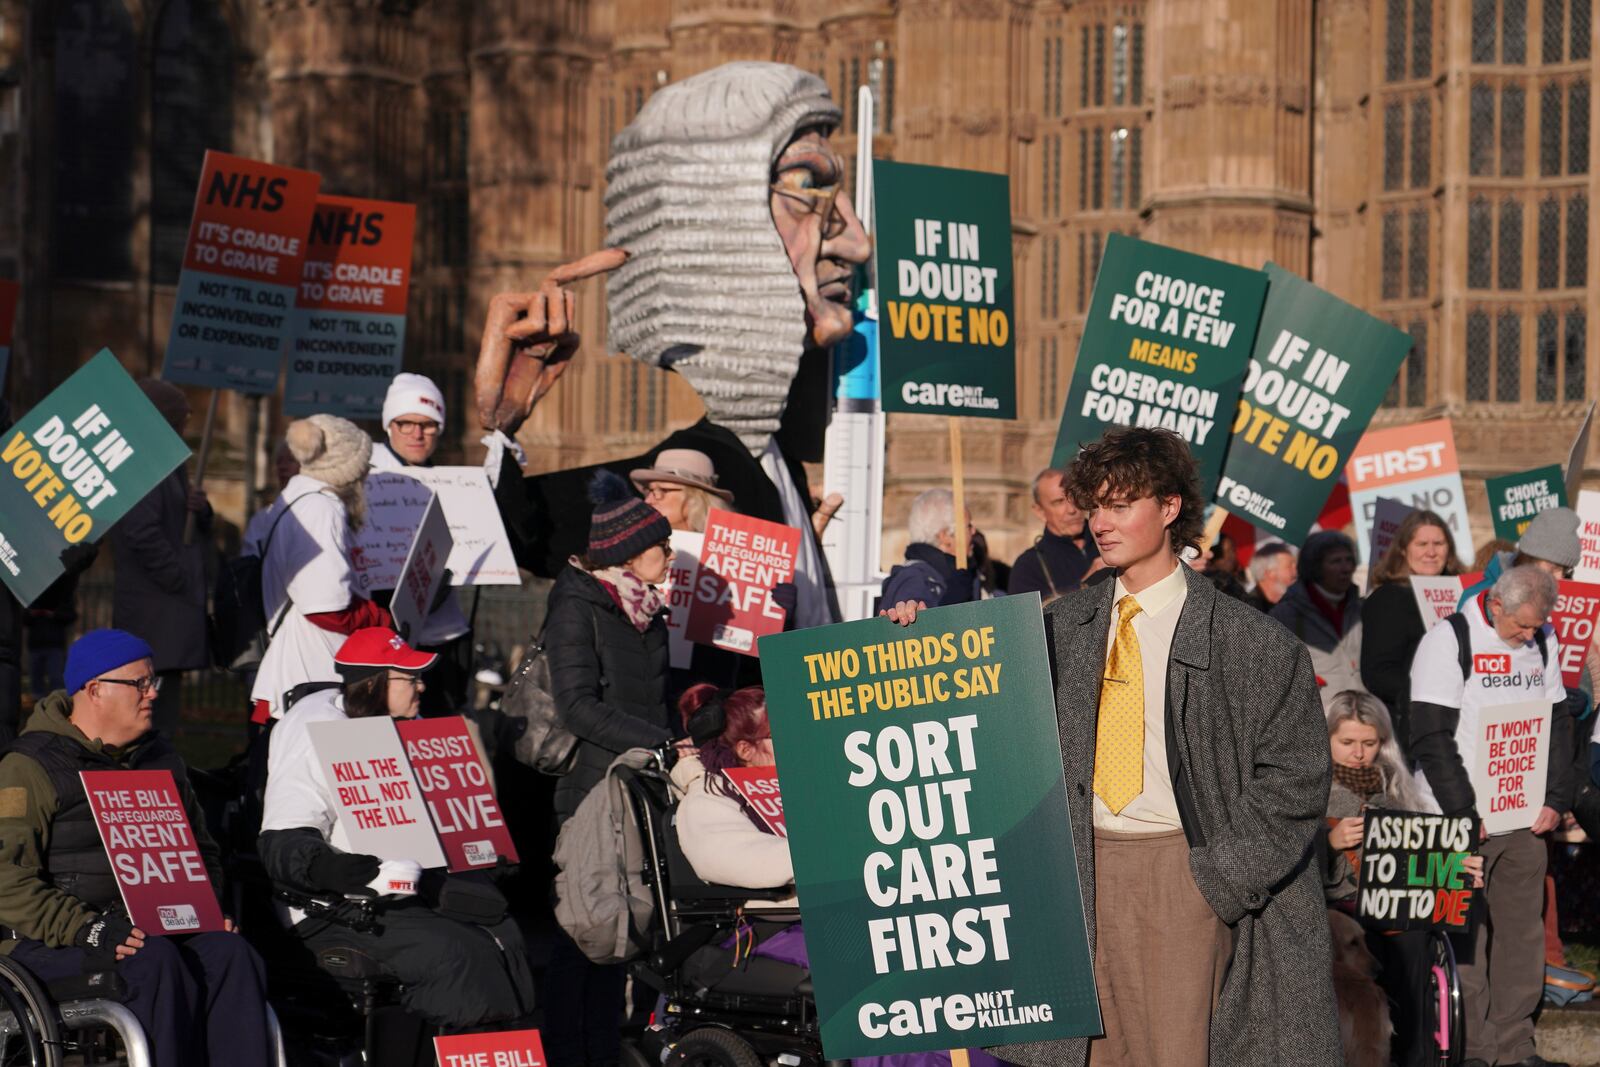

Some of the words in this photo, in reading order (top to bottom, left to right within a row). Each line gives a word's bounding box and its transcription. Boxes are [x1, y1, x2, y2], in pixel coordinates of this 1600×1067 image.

[205, 171, 287, 213] NHS
[199, 222, 230, 243] IT'S
[232, 227, 300, 256] CRADLE
[308, 211, 384, 245] NHS
[914, 218, 942, 257] IF
[948, 222, 980, 261] IN
[195, 244, 218, 263] TO
[222, 249, 278, 274] GRAVE
[303, 261, 332, 280] IT'S
[336, 263, 403, 285] CRADLE
[199, 282, 228, 298] NOT
[257, 291, 287, 309] OLD,
[302, 283, 323, 300] TO
[328, 285, 384, 306] GRAVE
[898, 259, 998, 305] DOUBT
[1135, 270, 1225, 317] CHOICE
[182, 302, 284, 328] INCONVENIENT
[309, 318, 337, 332] NOT
[367, 322, 397, 338] OLD,
[887, 301, 963, 343] VOTE
[968, 308, 1009, 347] NO
[1109, 293, 1160, 330] FOR
[1160, 308, 1179, 335] A
[1182, 312, 1236, 348] FEW
[178, 324, 198, 339] OR
[296, 338, 397, 356] INCONVENIENT
[1129, 338, 1198, 375] MEANS
[294, 360, 314, 373] OR
[1267, 329, 1310, 371] IF
[1302, 348, 1350, 396] IN
[902, 381, 964, 407] care
[1090, 363, 1219, 419] COERCION
[1081, 390, 1134, 426] FOR
[1135, 403, 1214, 446] MANY
[71, 403, 111, 439] IF
[92, 428, 134, 473] IN
[32, 415, 117, 510] DOUBT
[1283, 431, 1339, 480] NO
[1354, 442, 1446, 483] FIRST
[1, 431, 65, 508] VOTE
[47, 493, 94, 544] NO
[1412, 488, 1453, 511] NO
[1505, 480, 1549, 503] CHOICE
[1499, 501, 1524, 521] FOR
[1526, 500, 1535, 517] A
[707, 541, 790, 569] SAFEGUARDS
[712, 524, 748, 546] THE
[752, 534, 792, 558] BILL
[668, 567, 691, 586] HE
[704, 553, 790, 586] ARENT
[696, 575, 783, 619] SAFE
[1424, 588, 1457, 602] PLEASE
[1561, 617, 1593, 640] TO
[803, 648, 860, 684] TWO
[862, 633, 958, 675] THIRDS
[962, 626, 994, 660] OF
[1479, 656, 1506, 672] not
[807, 685, 855, 721] THE
[857, 672, 951, 714] PUBLIC
[954, 663, 1001, 699] SAY
[1482, 671, 1522, 688] dead
[1525, 673, 1544, 690] yet
[1486, 724, 1498, 741] IT
[1502, 718, 1544, 738] WON'T
[406, 735, 473, 761] ASSIST
[843, 714, 978, 788] SORT
[1489, 741, 1506, 758] BE
[1510, 737, 1537, 755] OUR
[332, 761, 369, 782] KILL
[368, 758, 402, 779] THE
[414, 765, 451, 792] US
[450, 761, 485, 788] TO
[1488, 755, 1536, 777] CHOICE
[94, 790, 134, 808] THE
[135, 790, 178, 807] BILL
[338, 785, 380, 807] BILL,
[381, 781, 412, 801] NOT
[1498, 775, 1523, 793] FOR
[101, 809, 183, 823] SAFEGUARDS
[352, 808, 387, 829] THE
[387, 805, 416, 826] ILL.
[428, 794, 503, 834] LIVE
[868, 778, 972, 846] OUT
[1490, 793, 1528, 813] LONG.
[110, 823, 189, 849] ARENT
[1365, 816, 1442, 850] ASSIST
[1440, 818, 1472, 852] US
[115, 850, 206, 885] SAFE
[863, 838, 1001, 908] CARE
[1365, 853, 1397, 883] TO
[1407, 852, 1471, 889] LIVE
[1361, 887, 1407, 919] NOT
[1408, 888, 1435, 919] TO
[1432, 888, 1472, 925] DIE
[868, 904, 1011, 975] FIRST
[975, 989, 1014, 1010] NOT
[858, 994, 976, 1039] care
[977, 1004, 1053, 1028] KILLING
[446, 1053, 490, 1067] THE
[493, 1049, 541, 1067] BILL
